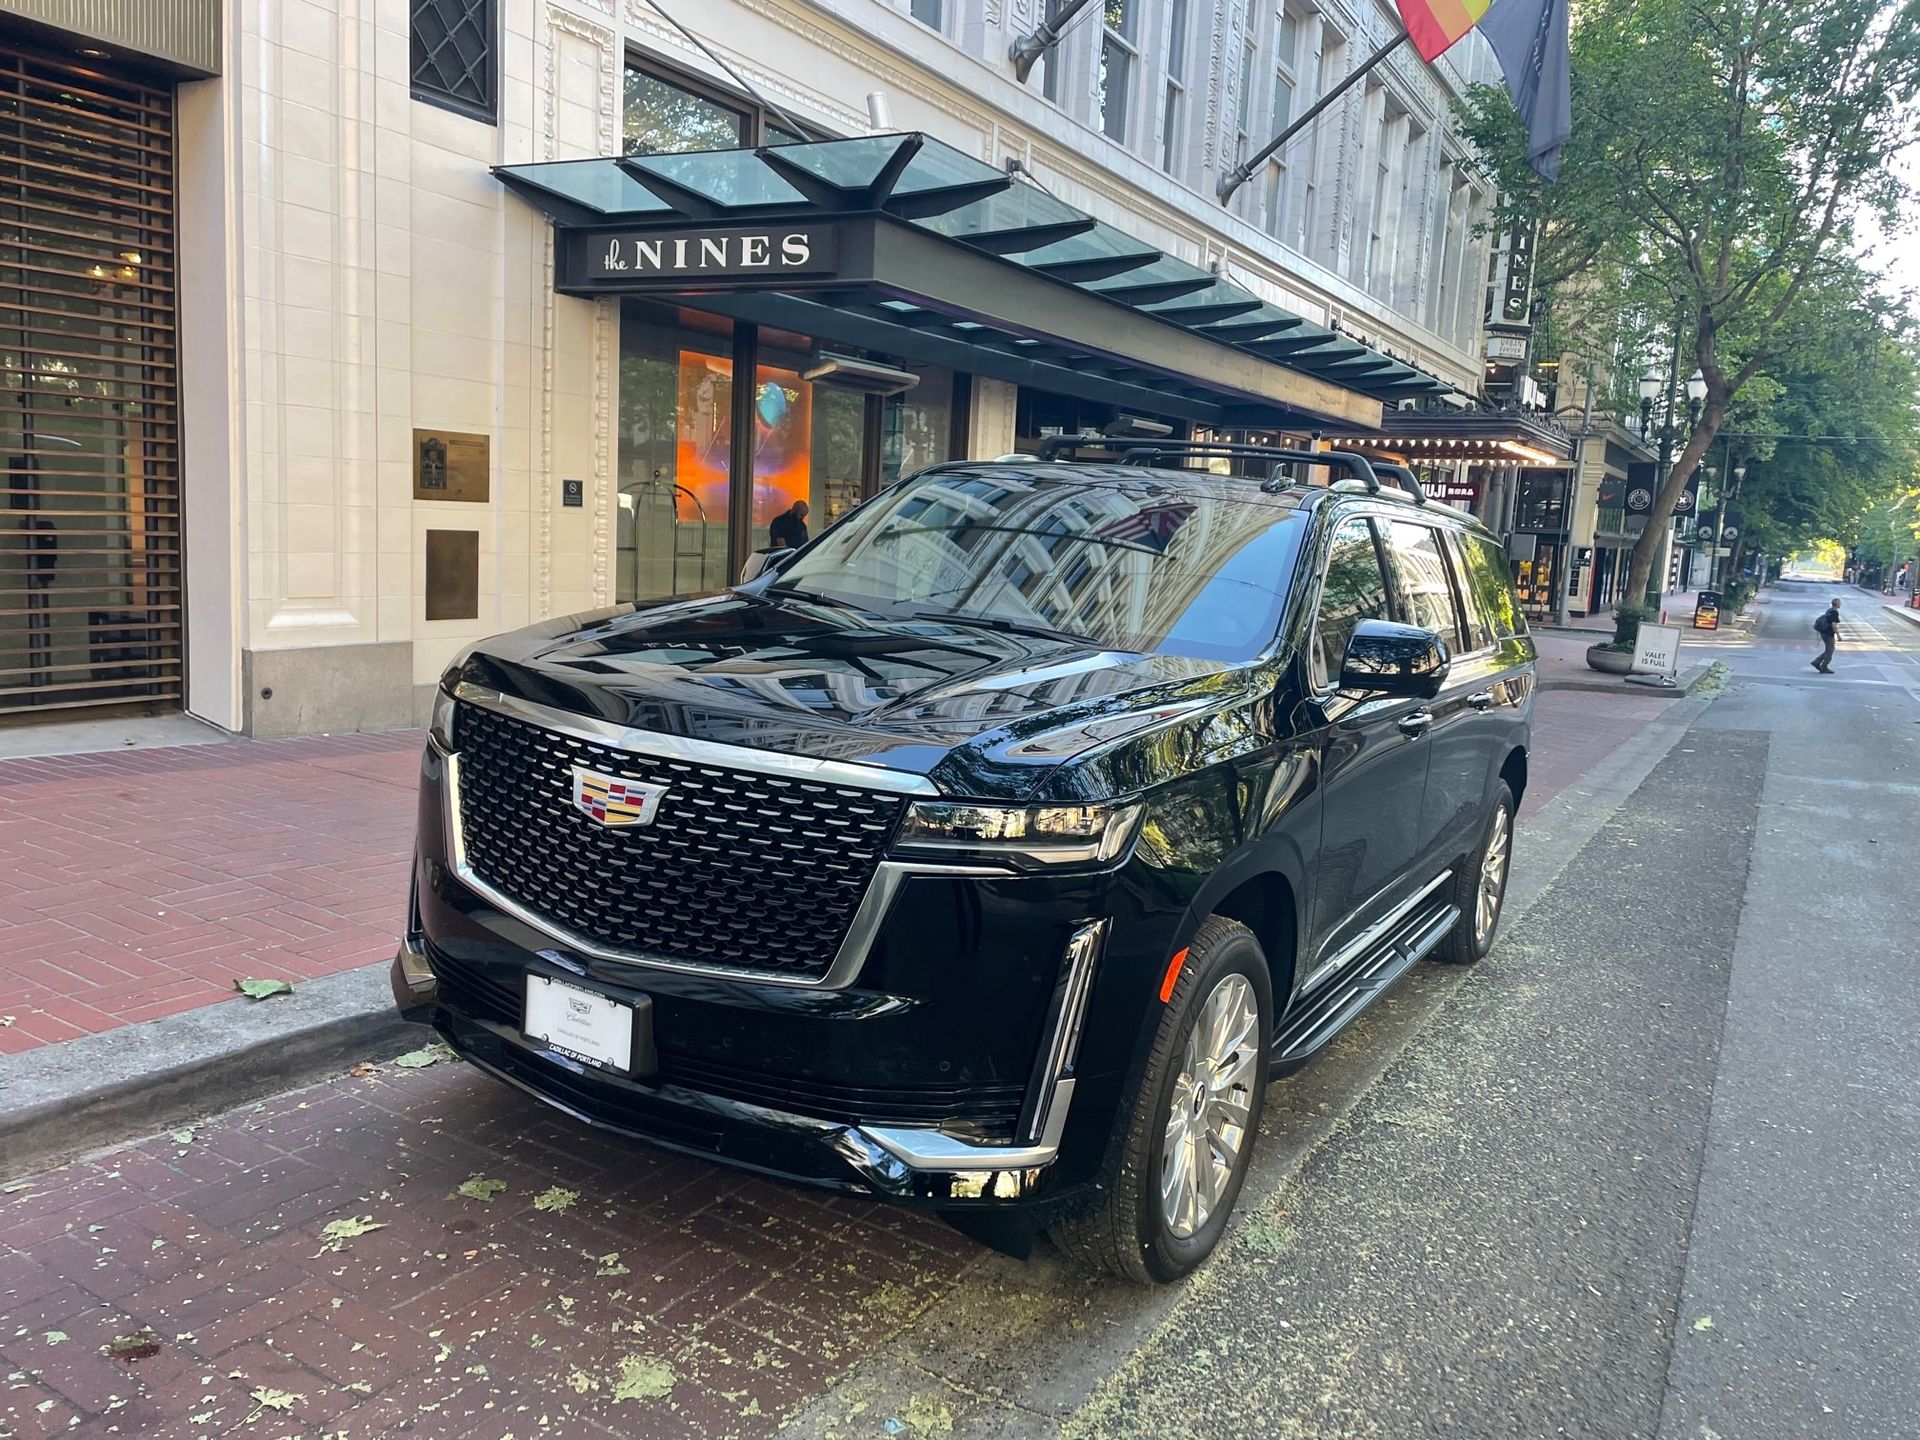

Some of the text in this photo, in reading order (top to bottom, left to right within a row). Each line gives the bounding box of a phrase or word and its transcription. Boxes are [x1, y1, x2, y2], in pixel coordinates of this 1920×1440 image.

[603, 233, 810, 270] the NINES
[1500, 338, 1522, 348] URBAN
[1645, 651, 1666, 660] VALET
[1650, 659, 1666, 667] FULL
[549, 1044, 571, 1056] CADILLAC
[577, 1054, 602, 1067] PORTLAND
